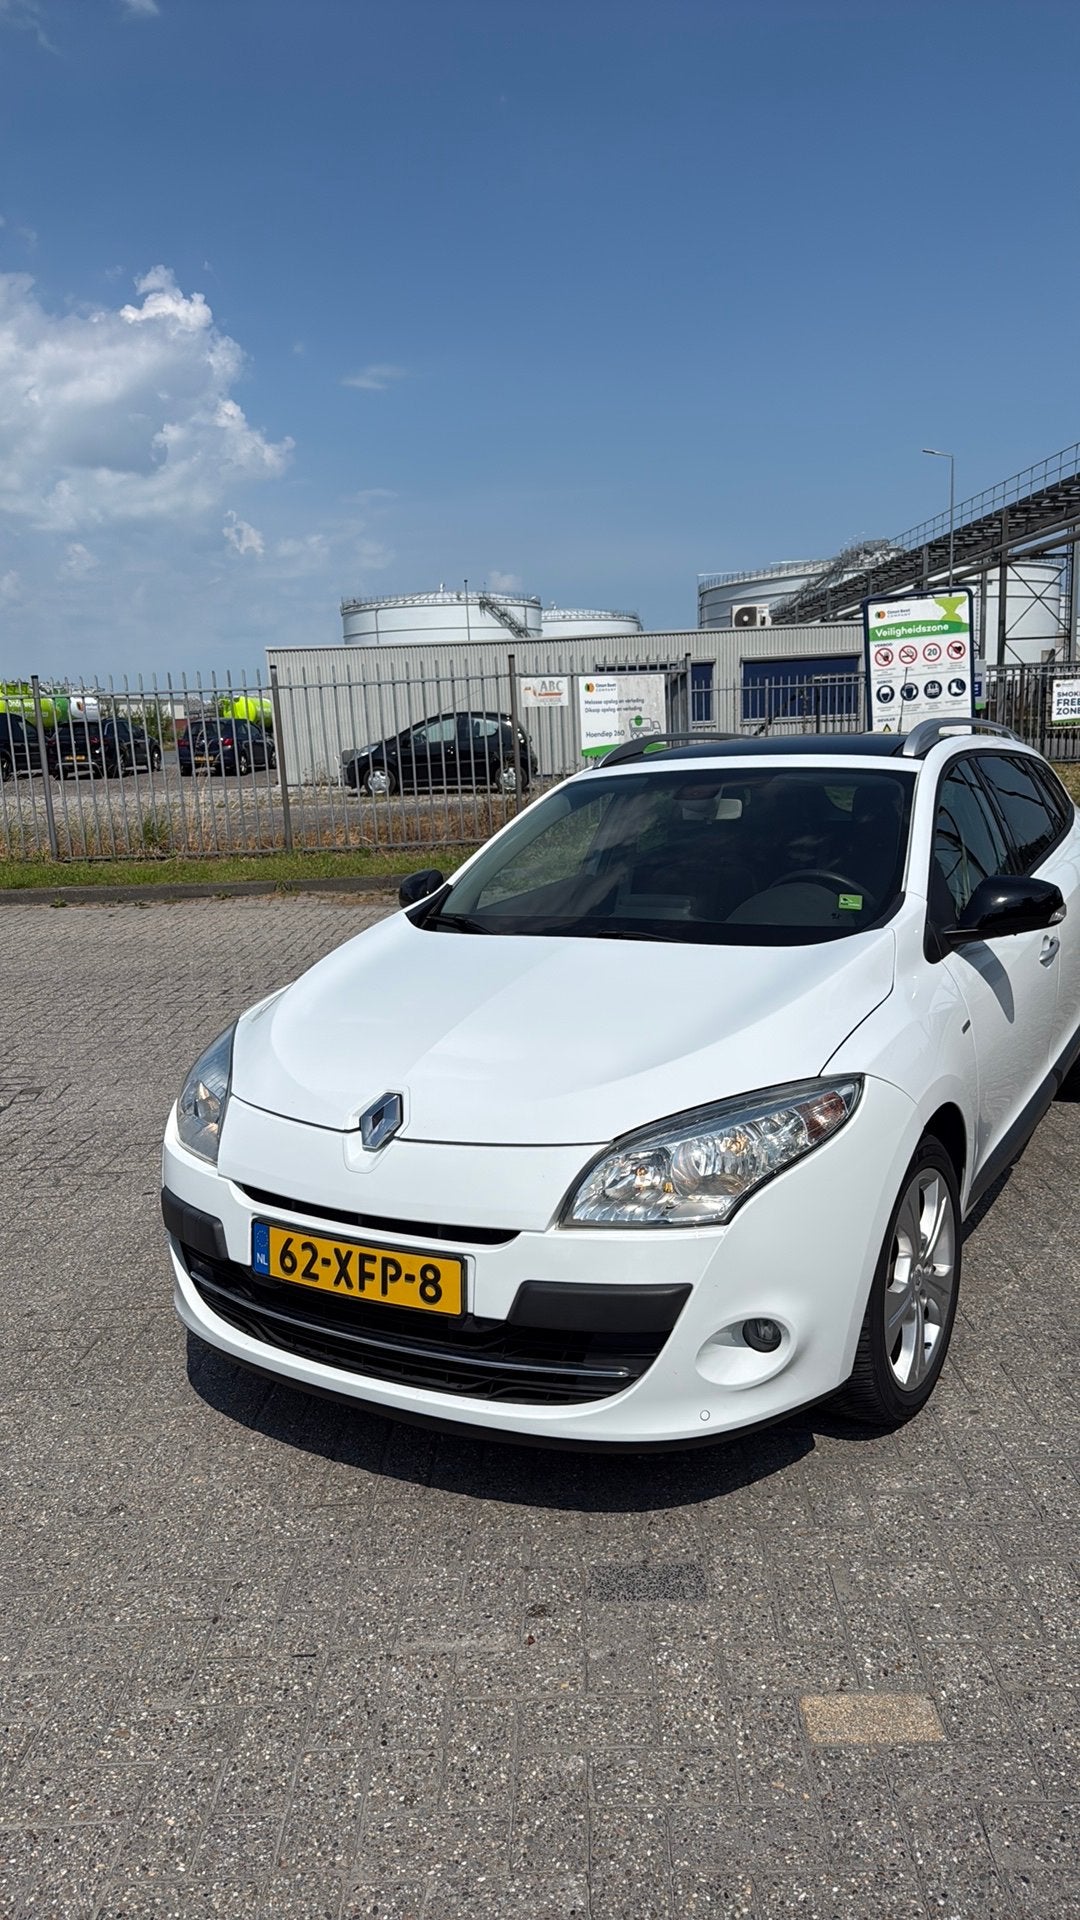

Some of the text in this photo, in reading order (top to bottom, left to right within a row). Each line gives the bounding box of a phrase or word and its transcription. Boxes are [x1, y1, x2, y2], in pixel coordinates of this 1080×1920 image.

[875, 623, 949, 637] Veiligheidszone
[927, 648, 938, 656] 20
[540, 680, 563, 691] ABC
[256, 1252, 268, 1266] NL
[279, 1237, 443, 1305] 62-XFP-8
